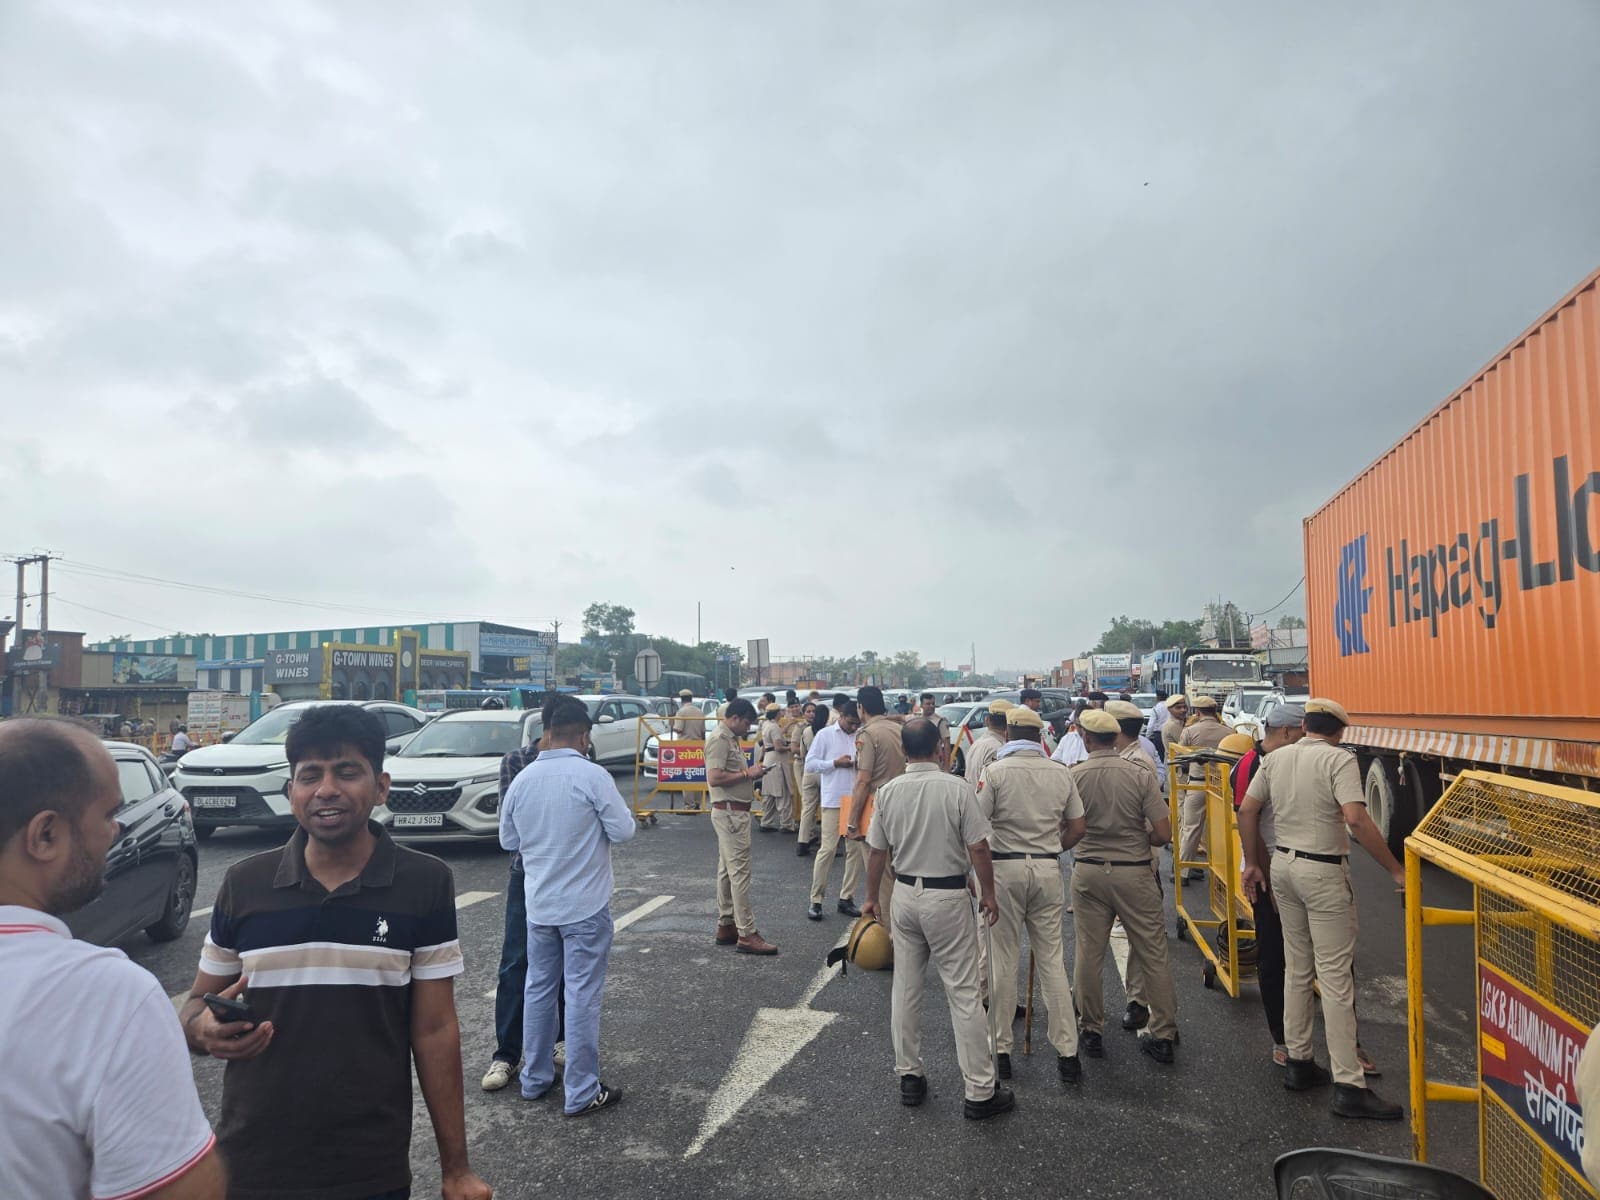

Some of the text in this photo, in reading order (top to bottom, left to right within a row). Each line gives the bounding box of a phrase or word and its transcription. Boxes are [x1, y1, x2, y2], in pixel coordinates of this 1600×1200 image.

[275, 653, 309, 664] G-TOWN
[333, 651, 394, 667] G-TOWN WINES
[276, 667, 309, 678] WINES
[678, 749, 705, 760] सोनी
[1507, 996, 1563, 1078] ALUMINIUM
